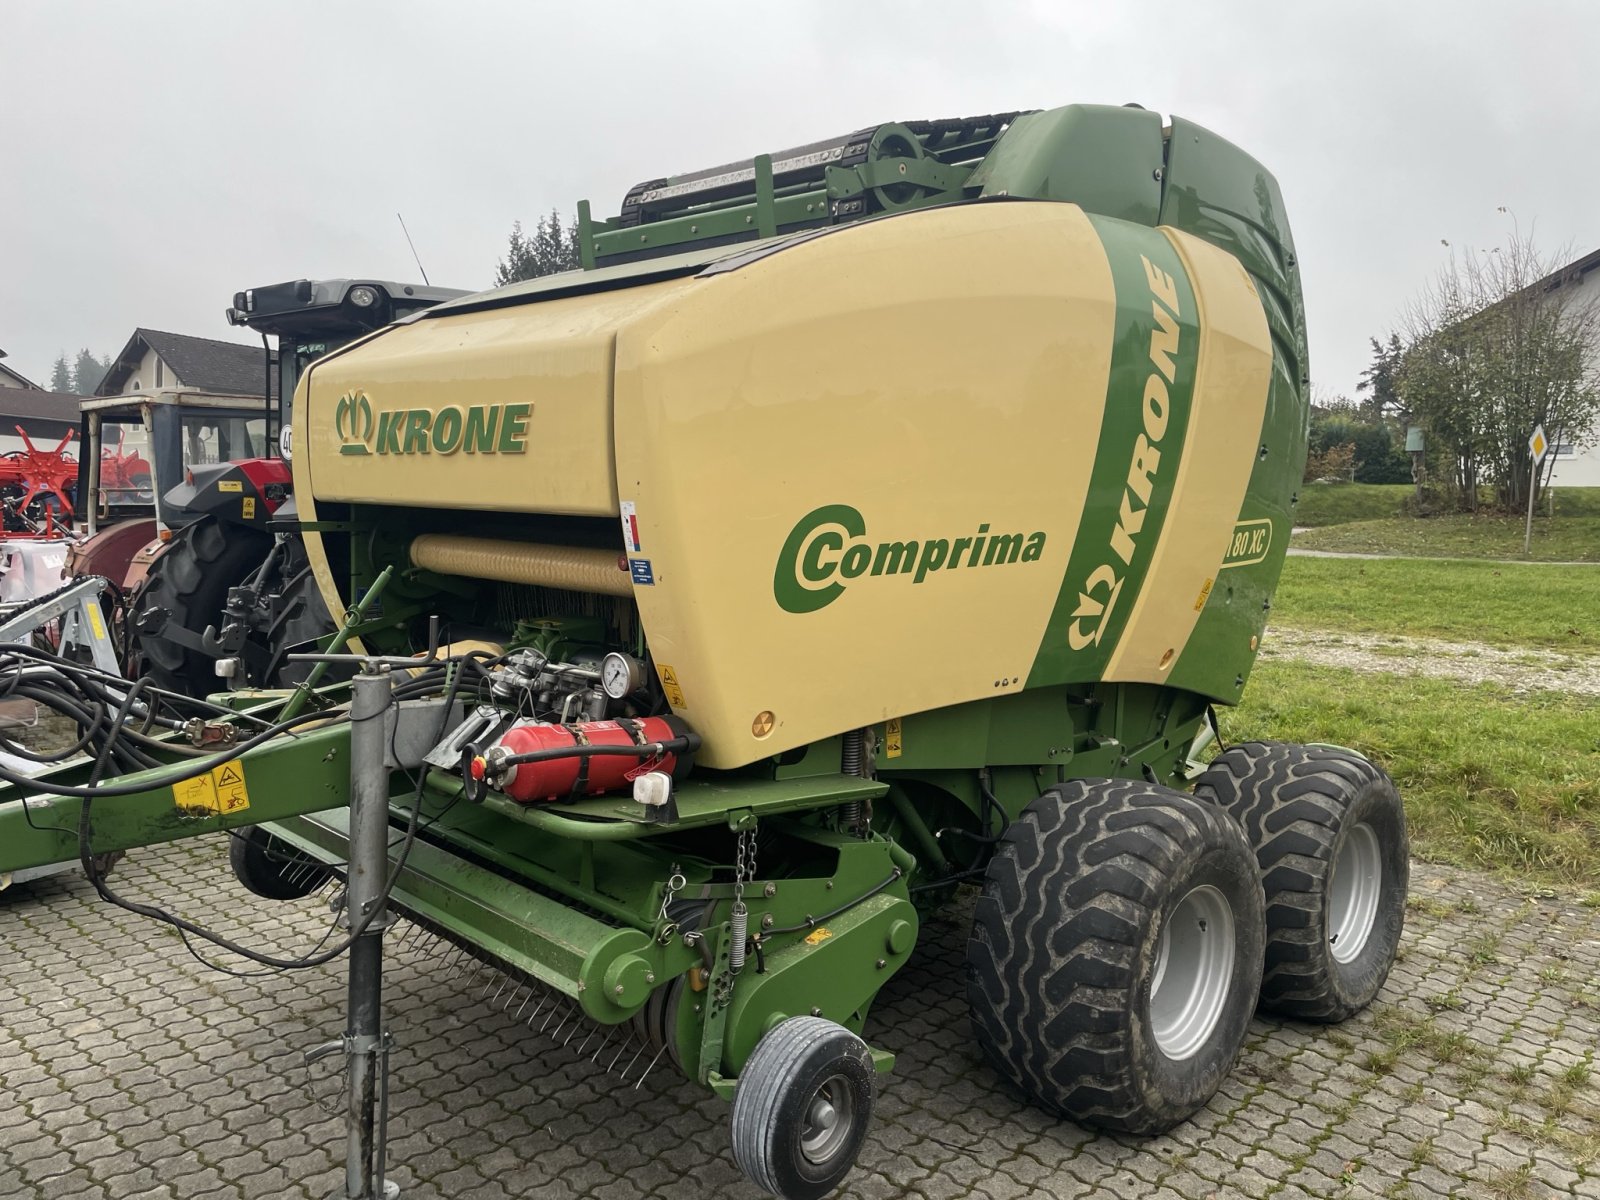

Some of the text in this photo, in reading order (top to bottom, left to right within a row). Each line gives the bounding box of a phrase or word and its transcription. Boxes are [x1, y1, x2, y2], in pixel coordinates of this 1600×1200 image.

[375, 402, 532, 455] KRONE
[1110, 255, 1180, 564] KRONE
[774, 504, 1047, 613] Comprima
[1248, 528, 1266, 555] XC
